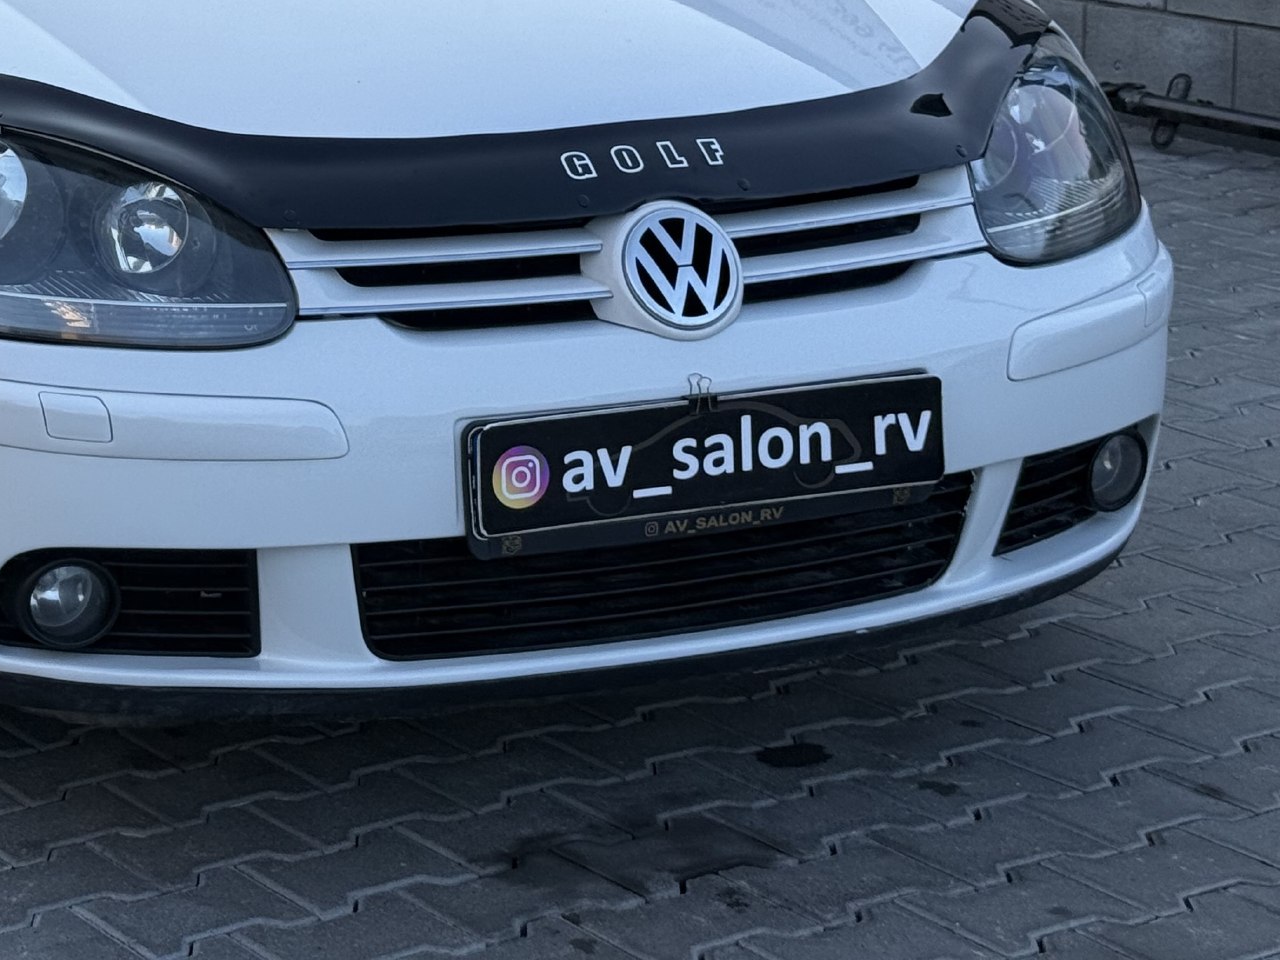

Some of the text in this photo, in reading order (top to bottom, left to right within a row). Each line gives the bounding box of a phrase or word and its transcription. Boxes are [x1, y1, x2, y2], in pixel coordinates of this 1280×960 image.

[560, 138, 725, 180] GOLF
[561, 409, 932, 499] av_salon_rv
[664, 506, 785, 534] AV_SALON_RV
